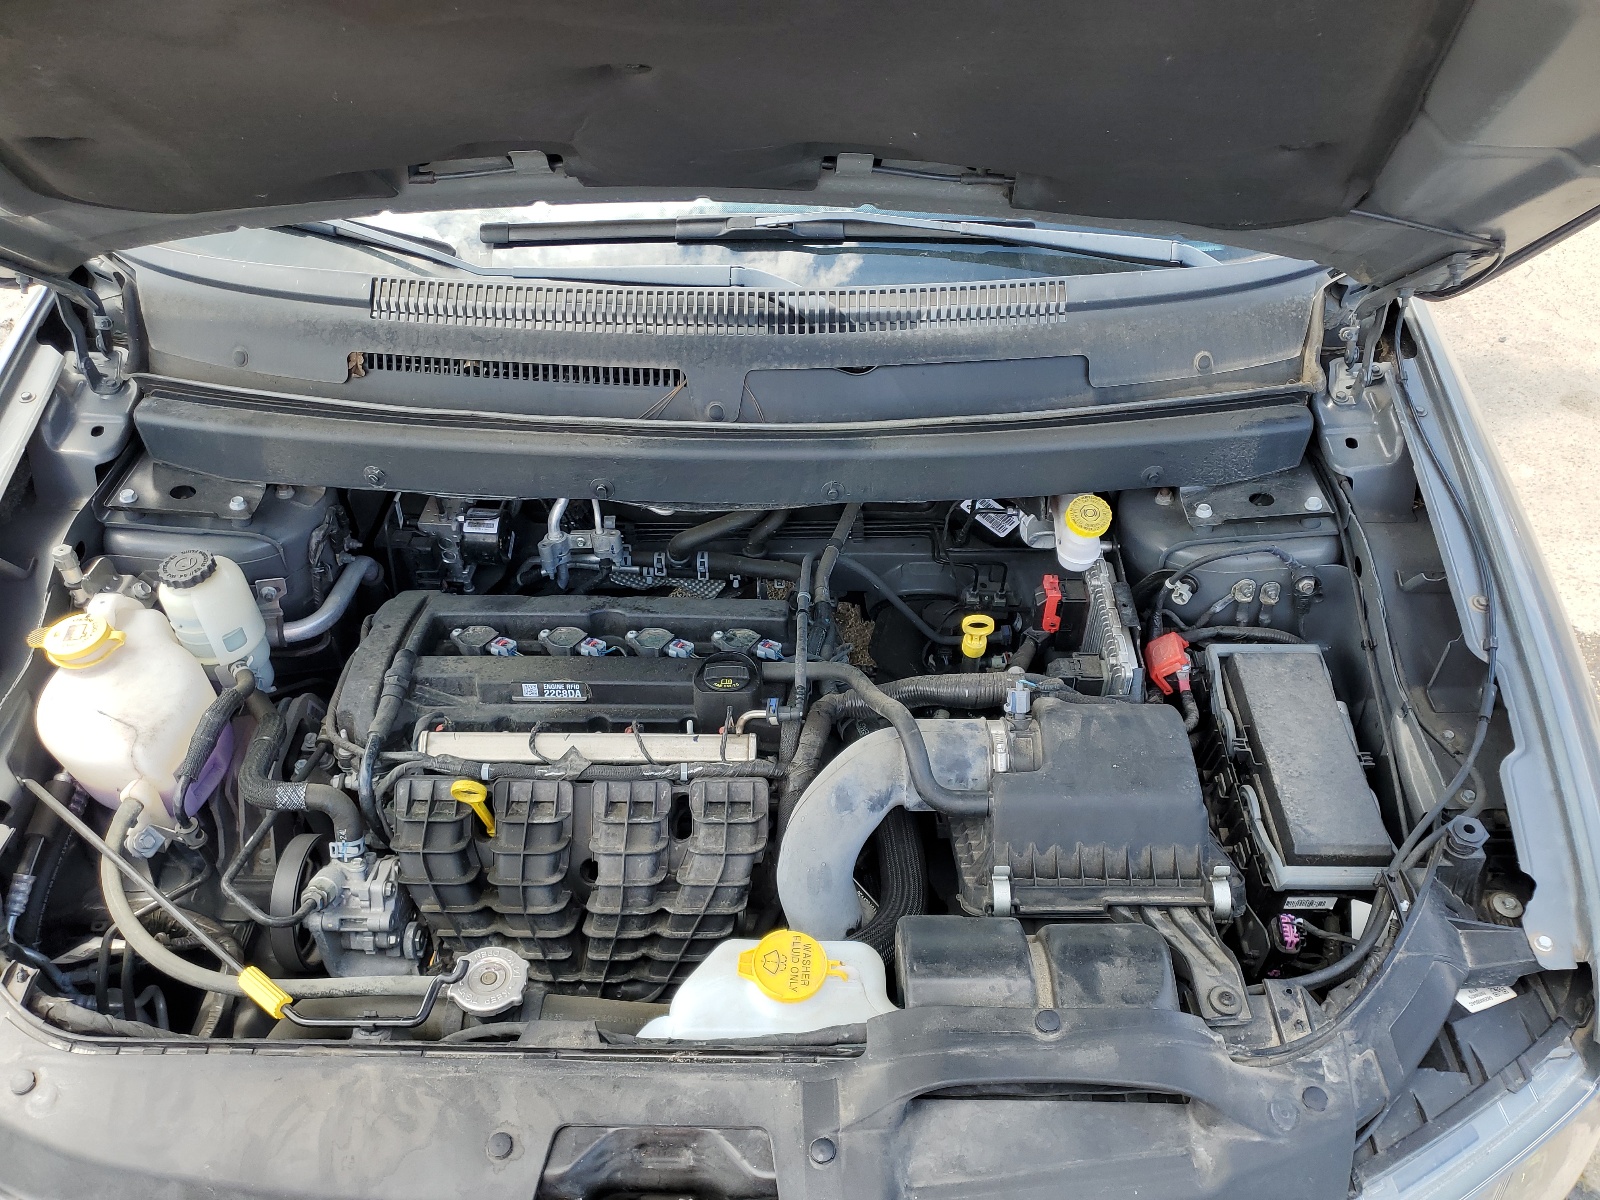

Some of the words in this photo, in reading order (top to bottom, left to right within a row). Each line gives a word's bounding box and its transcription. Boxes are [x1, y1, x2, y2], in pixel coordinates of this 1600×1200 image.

[543, 689, 582, 698] 22C8DA
[474, 950, 499, 960] OPEN
[791, 935, 801, 963] FLUID
[801, 943, 811, 986] WASHER
[789, 967, 799, 992] ONLY
[484, 991, 511, 1005] KEEP
